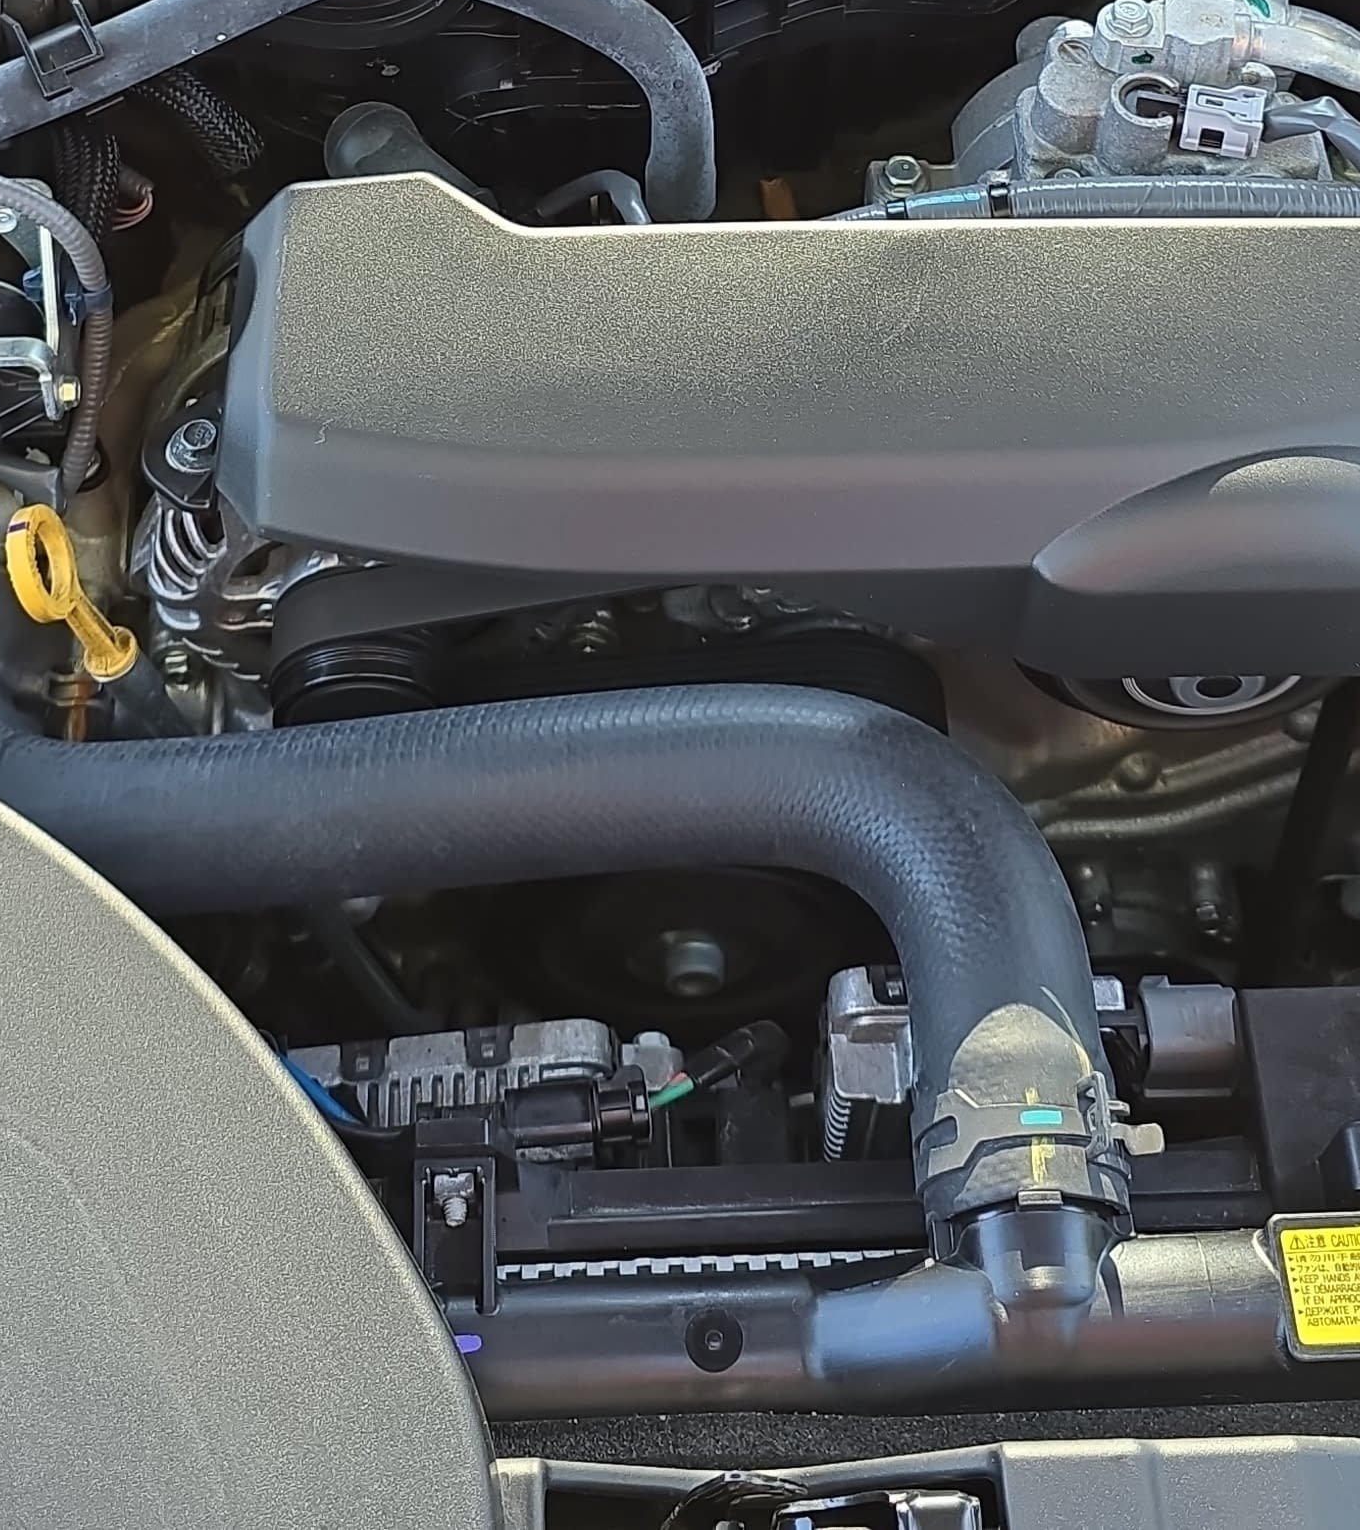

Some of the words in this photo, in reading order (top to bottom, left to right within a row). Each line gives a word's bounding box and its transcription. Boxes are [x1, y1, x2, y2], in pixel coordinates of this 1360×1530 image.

[1299, 1274, 1319, 1283] KEEP
[1323, 1273, 1351, 1282] HANDS
[1301, 1286, 1310, 1295] LE
[1305, 1306, 1349, 1317] ДЕРЖИТЕ
